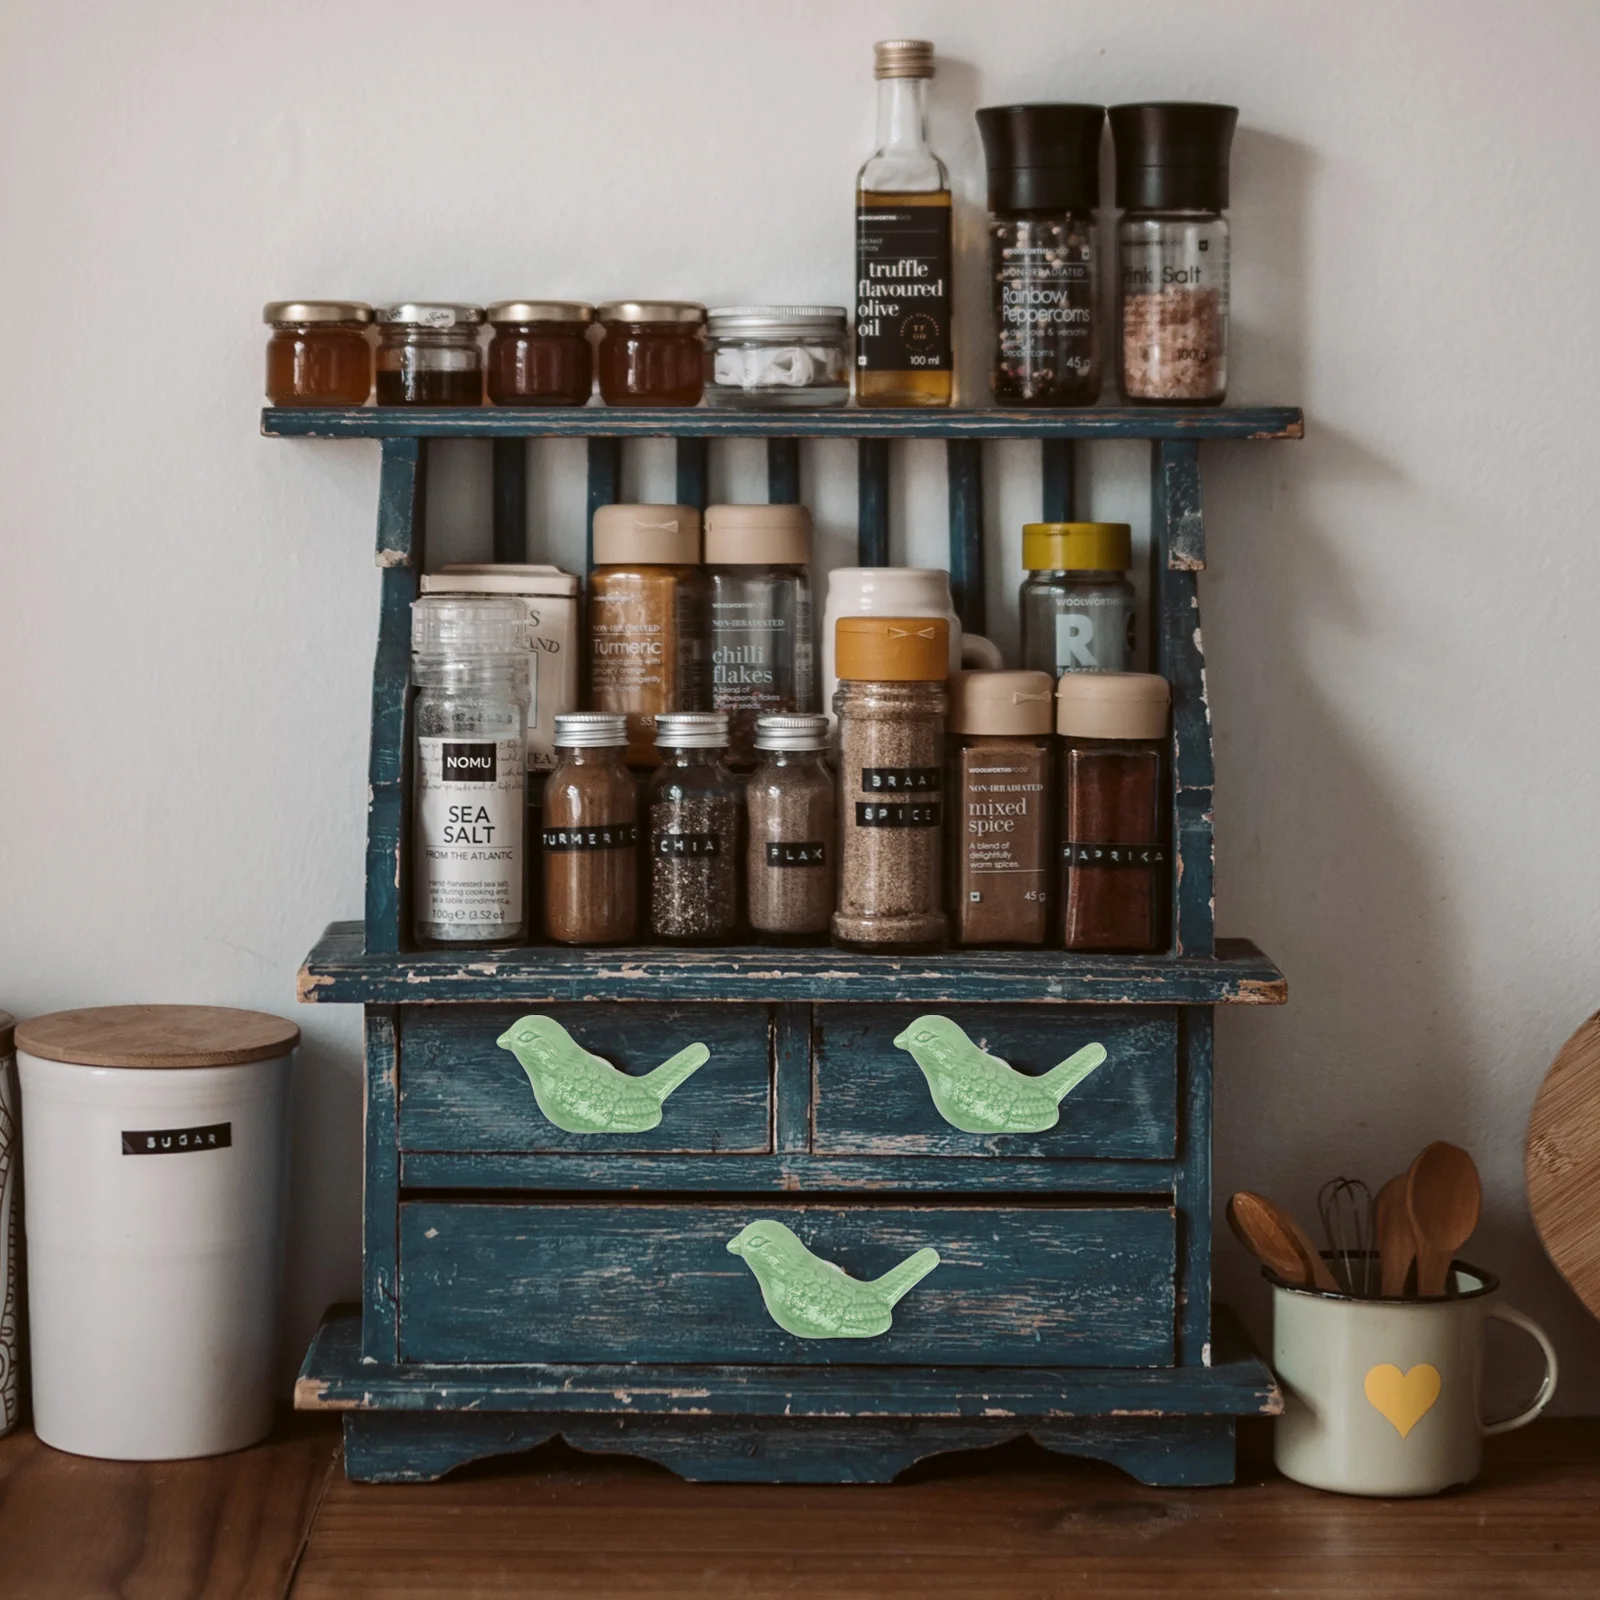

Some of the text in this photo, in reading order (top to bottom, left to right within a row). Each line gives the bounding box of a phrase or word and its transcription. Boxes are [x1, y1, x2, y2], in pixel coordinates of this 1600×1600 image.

[869, 260, 928, 278] truffle
[1162, 266, 1202, 284] Salt
[858, 279, 943, 297] flavoured
[1003, 287, 1067, 304] Rainbow
[858, 300, 899, 317] olive
[1003, 304, 1090, 326] Peppercorns
[858, 319, 880, 336] oil
[910, 355, 940, 365] 100 ml
[1066, 356, 1081, 368] 45
[593, 638, 662, 655] Turmeric
[1056, 614, 1099, 667] R
[712, 645, 763, 664] chilli
[713, 665, 773, 684] flakes
[447, 756, 491, 769] NOMU
[872, 775, 935, 788] BRAAI
[969, 783, 1043, 793] NON-IRRADIATED
[864, 807, 931, 821] SPICE
[969, 797, 1028, 816] mixed
[448, 806, 491, 824] SEA
[969, 816, 1015, 837] spice
[443, 826, 496, 844] SALT
[542, 828, 637, 846] TURMERIC
[660, 840, 714, 852] CHIA
[977, 842, 1000, 850] blend
[426, 851, 513, 861] FROM THE ATLANTIC
[771, 848, 823, 861] FLAX
[969, 851, 1012, 860] delightfully
[1063, 847, 1164, 862] PAPRIKA
[994, 860, 1020, 869] spices.
[465, 888, 494, 896] cooking
[1024, 891, 1046, 902] 45 g
[146, 1134, 216, 1149] SUGAR
